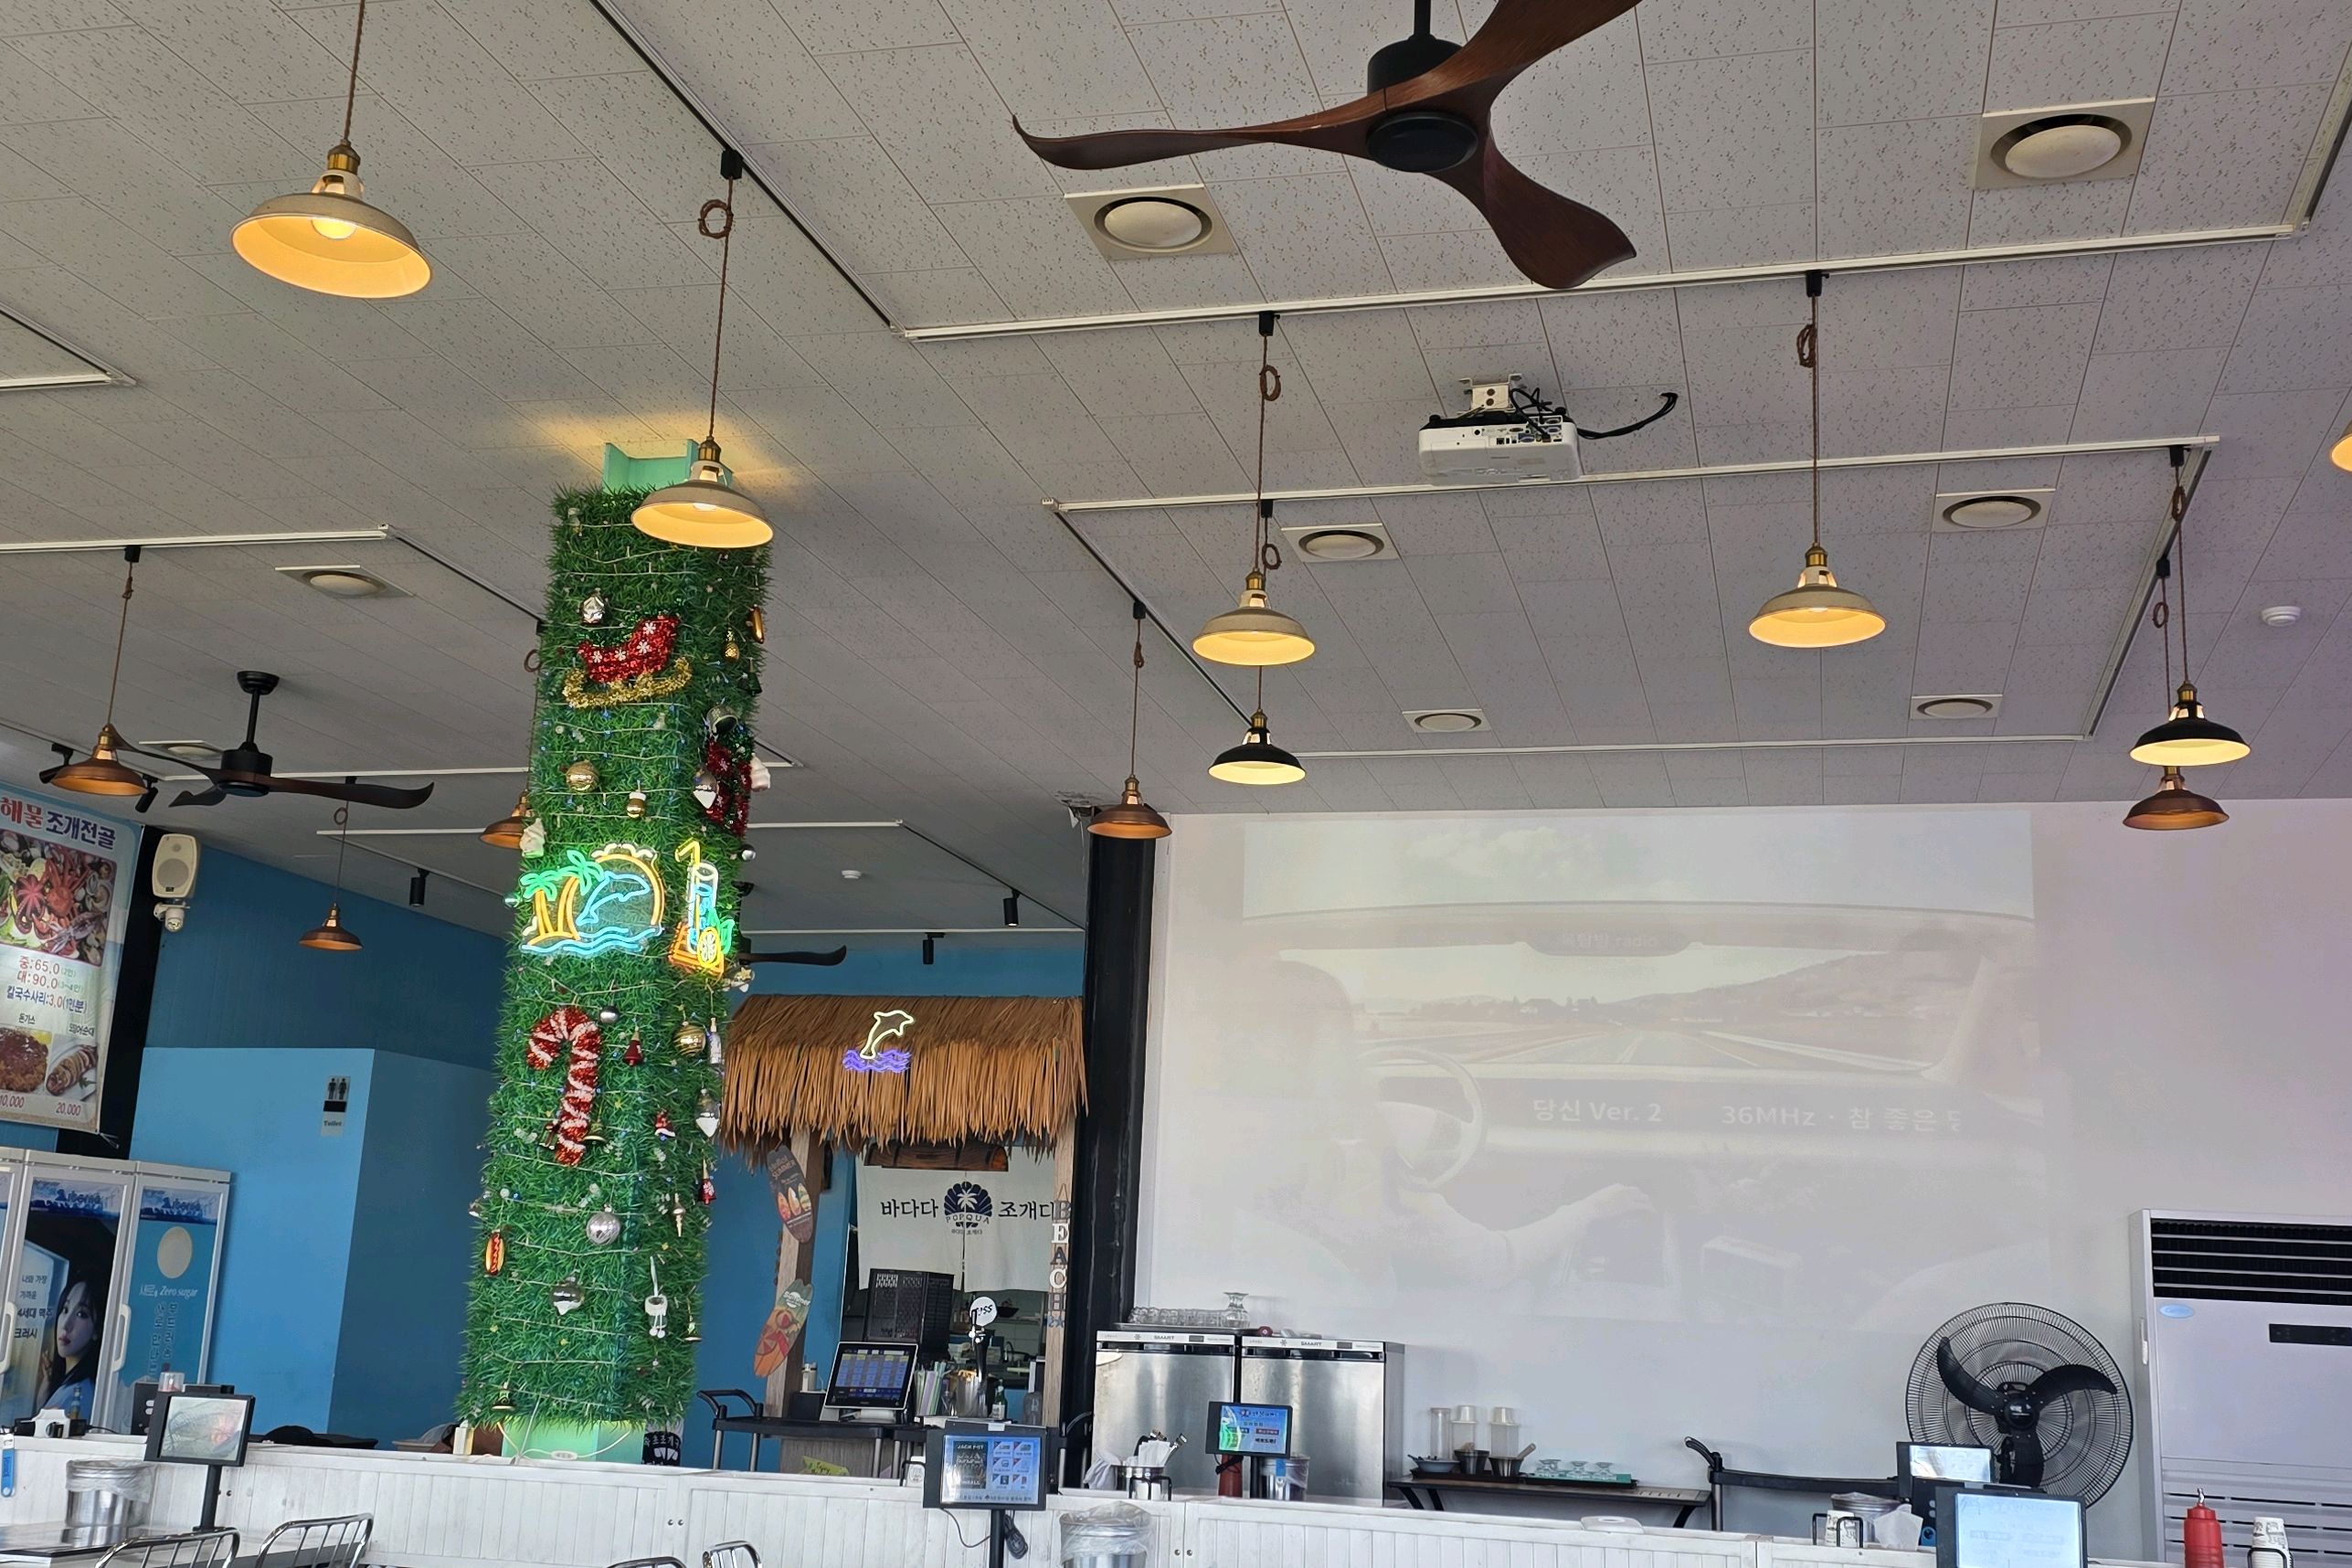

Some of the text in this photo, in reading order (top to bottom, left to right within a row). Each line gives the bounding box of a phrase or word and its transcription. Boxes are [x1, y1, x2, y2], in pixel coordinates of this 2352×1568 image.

[0, 797, 116, 850] 해물 조개전골
[1532, 1098, 1663, 1122] 당신 Ver. 2
[1721, 1105, 1817, 1127] 36MHz
[1849, 1106, 1874, 1130] 참
[880, 1198, 938, 1218] 바다다
[946, 1213, 990, 1224] POPQUA
[1048, 1200, 1071, 1311] BEACH
[159, 1286, 177, 1296] Zero
[14, 1328, 37, 1339] 크러시
